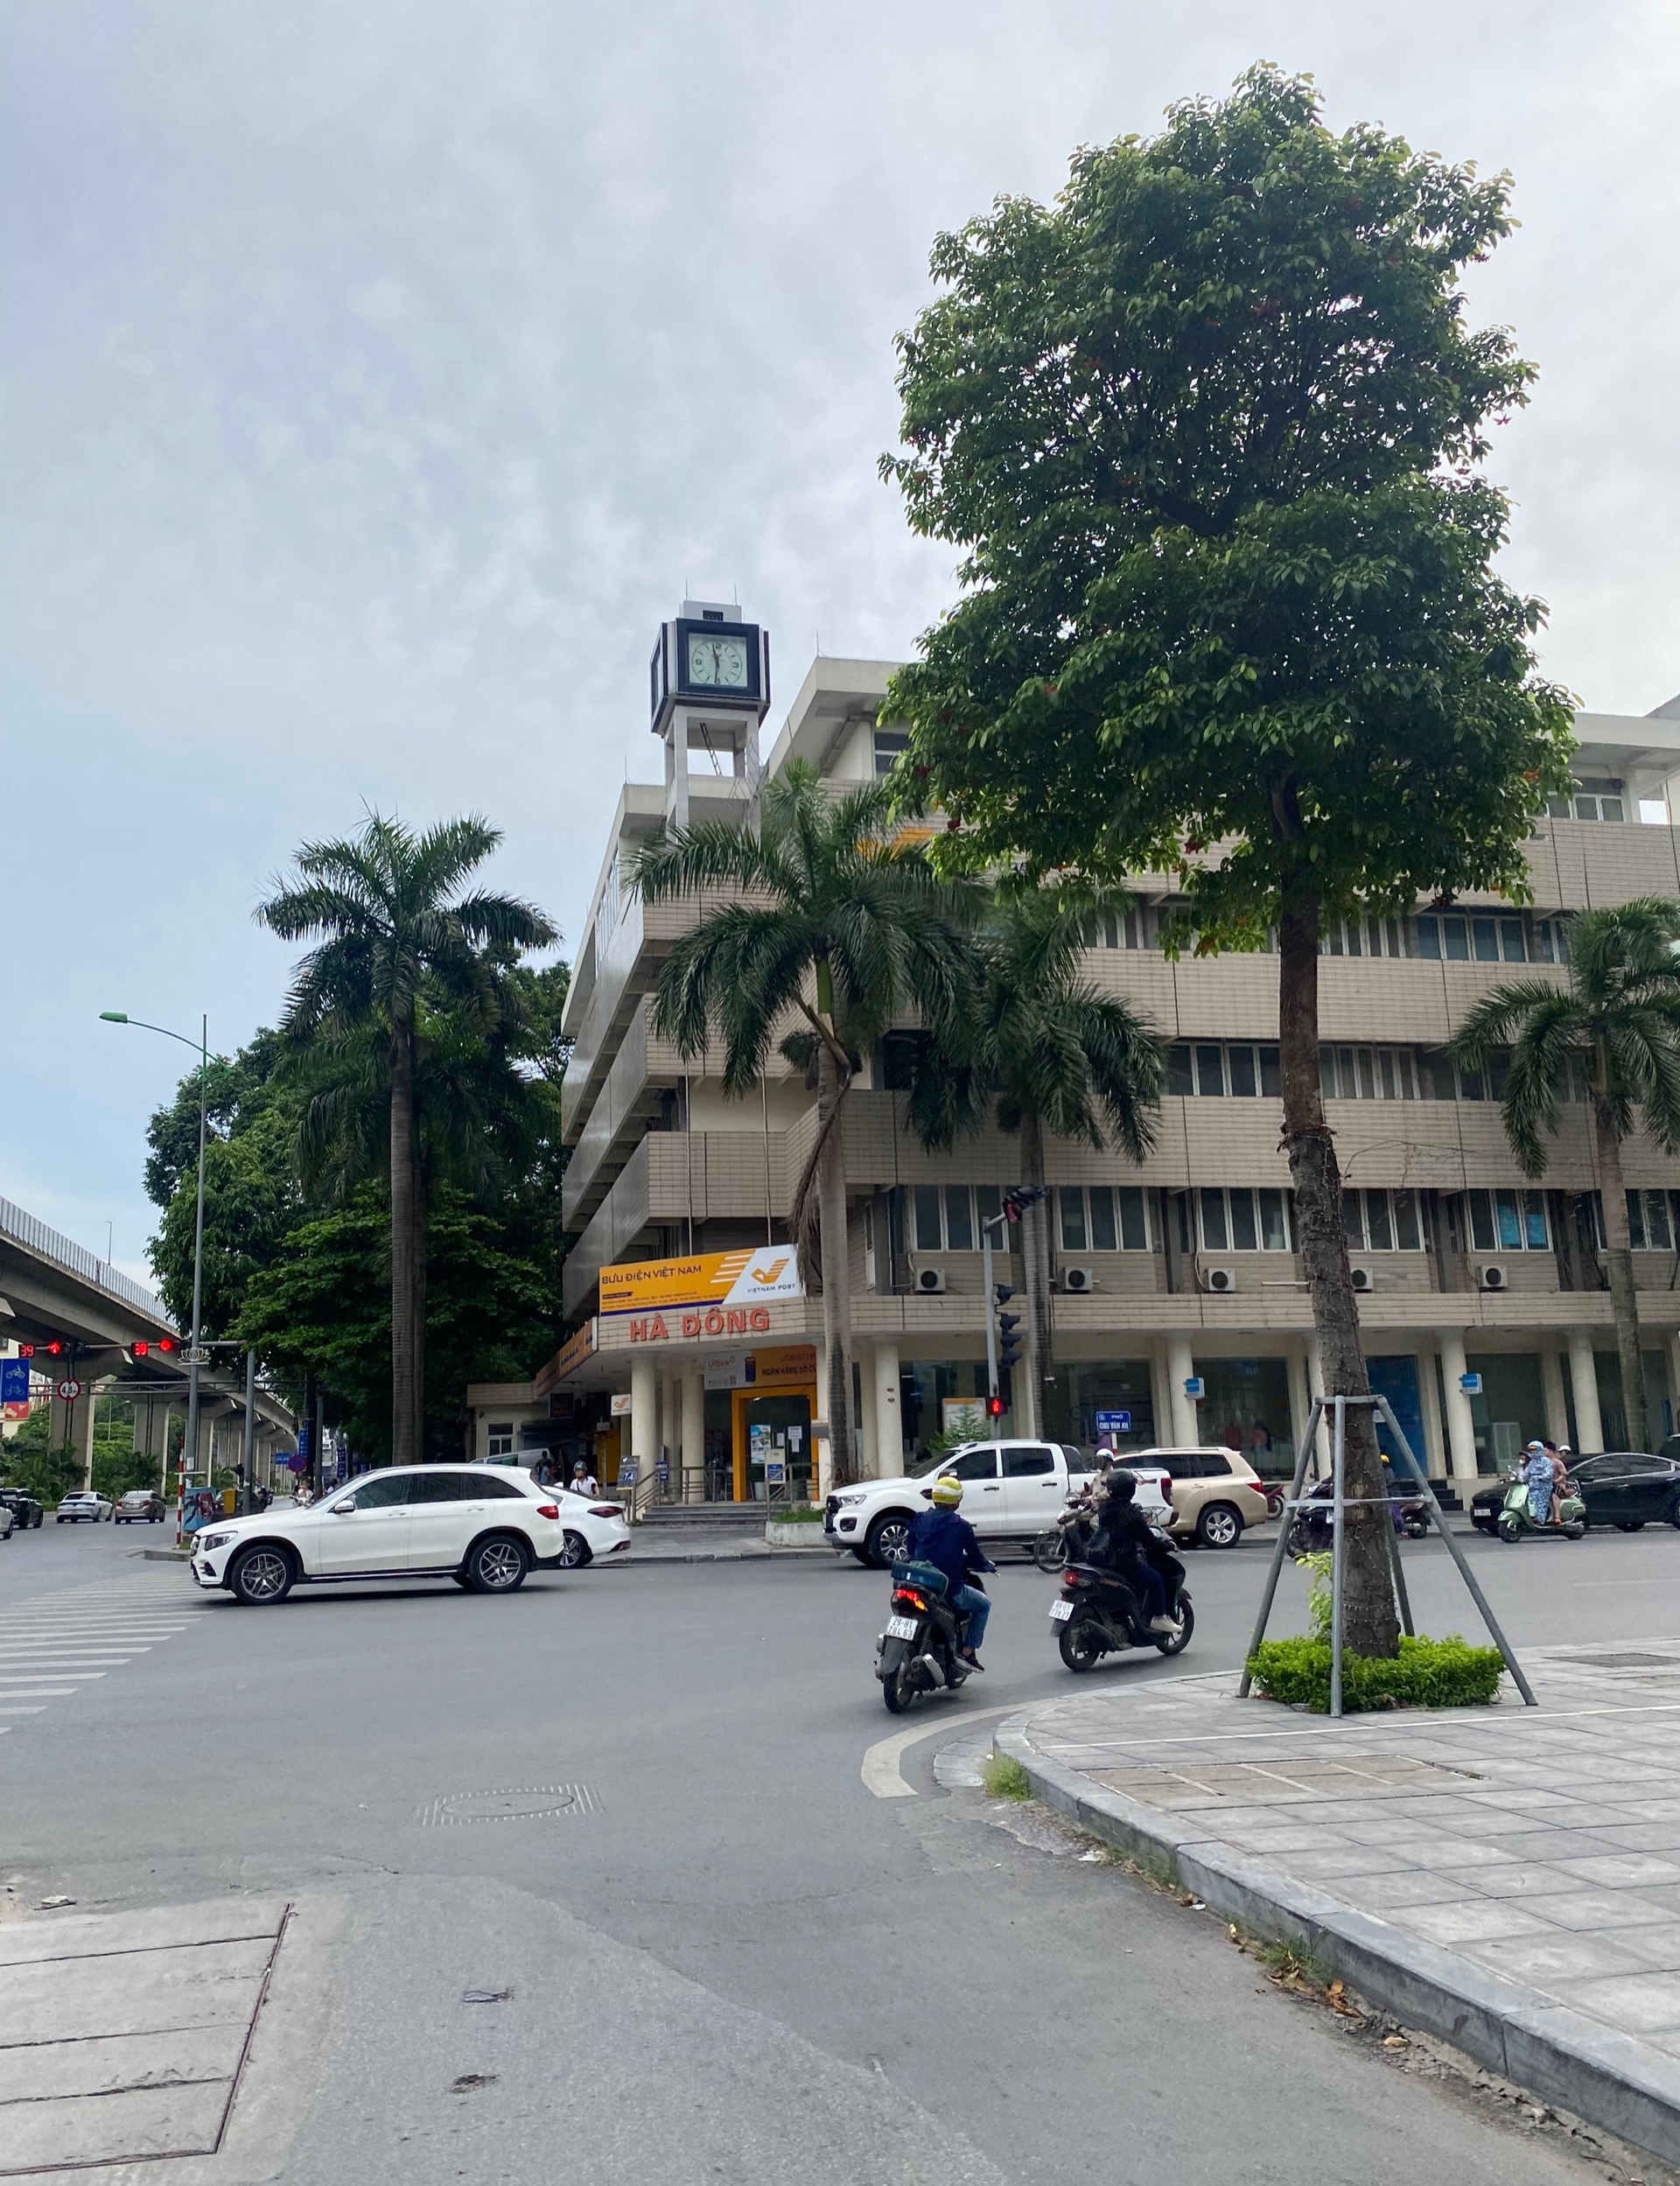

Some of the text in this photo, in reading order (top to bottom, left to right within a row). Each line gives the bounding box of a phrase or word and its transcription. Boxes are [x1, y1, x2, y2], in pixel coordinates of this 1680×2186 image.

[602, 1272, 623, 1285] BƯU
[626, 1270, 651, 1283] ĐIỆN
[653, 1266, 676, 1279] VIỆT
[747, 1285, 775, 1293] VIETNAM
[630, 1307, 769, 1342] HÀ ĐÔNG
[21, 1345, 33, 1356] 39
[892, 1618, 914, 1629] 29-H1
